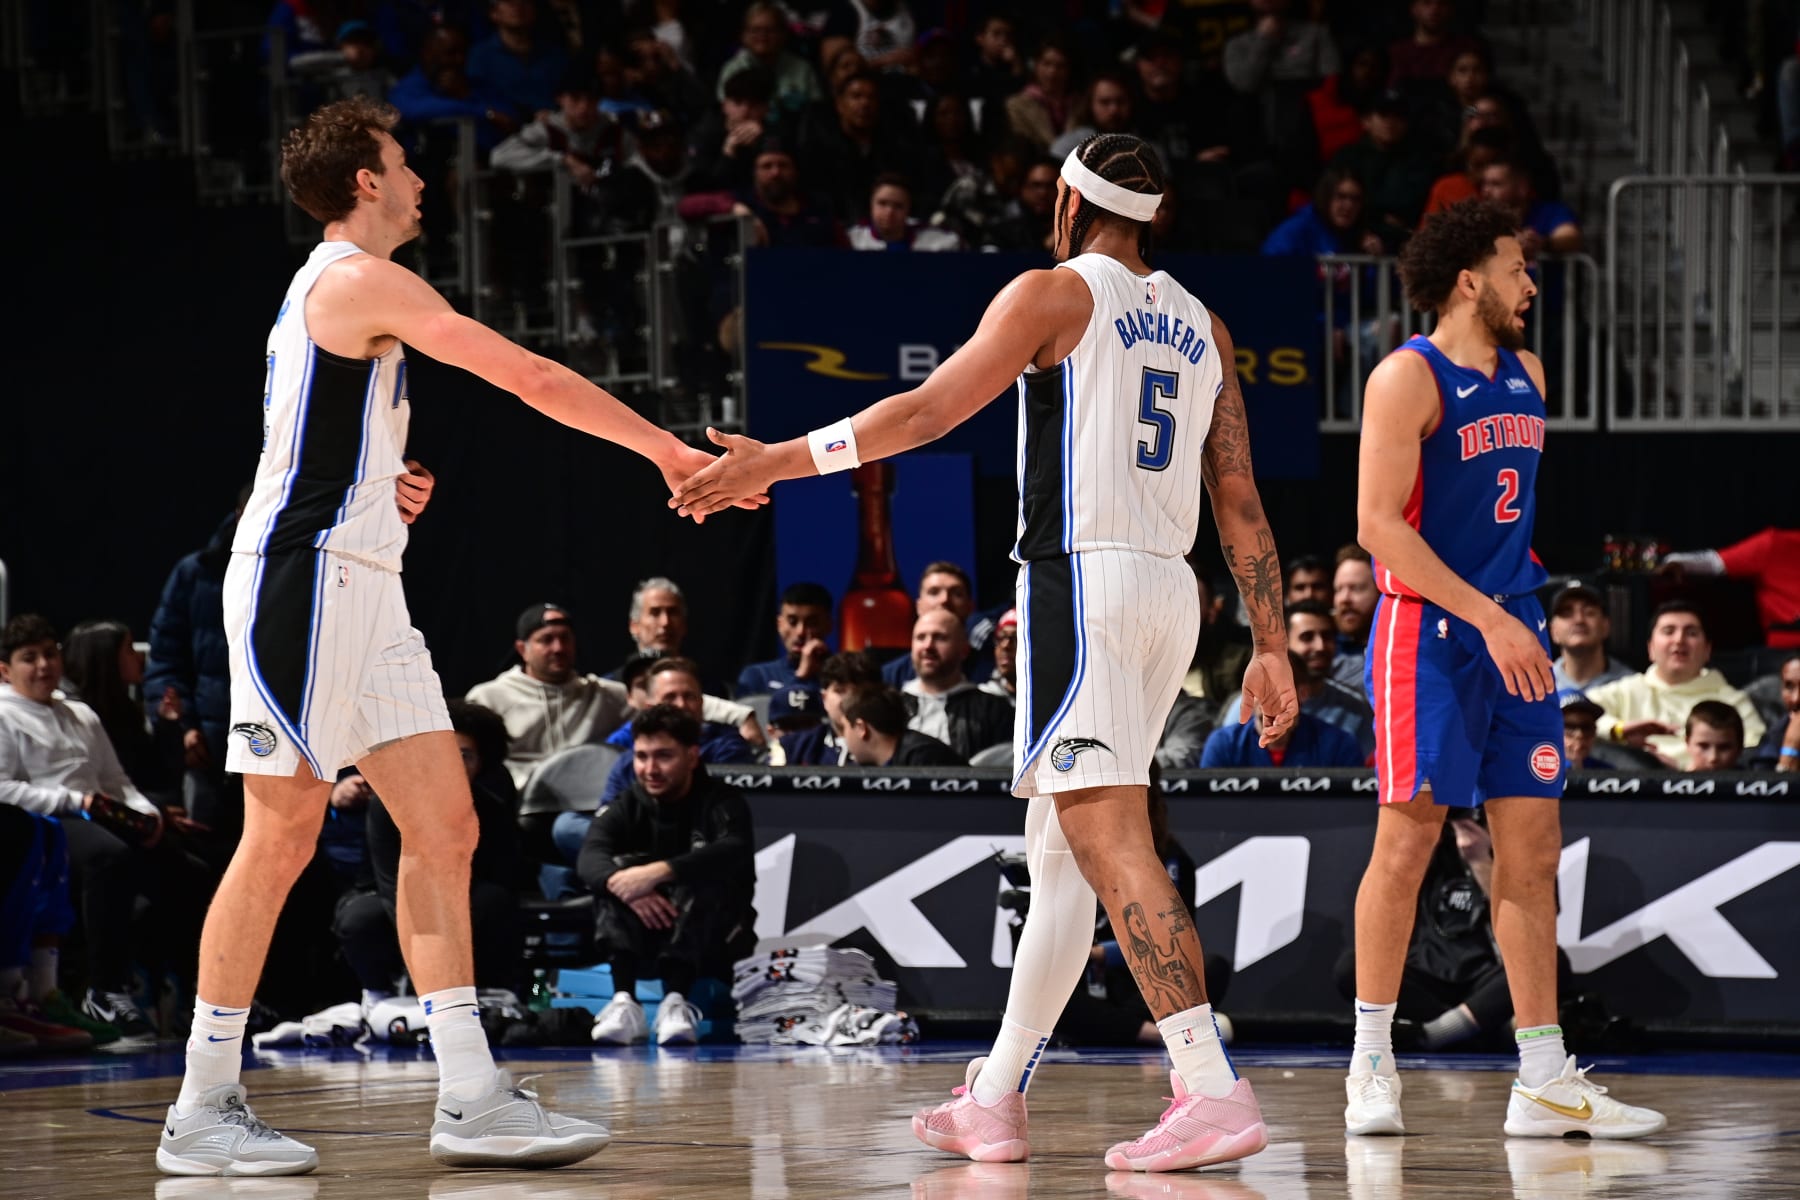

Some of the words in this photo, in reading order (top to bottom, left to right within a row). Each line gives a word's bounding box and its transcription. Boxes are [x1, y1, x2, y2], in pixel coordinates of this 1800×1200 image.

[1114, 308, 1206, 365] BANCHERO
[1136, 365, 1179, 472] 5
[1494, 468, 1521, 523] 2
[1160, 778, 1189, 793] IA
